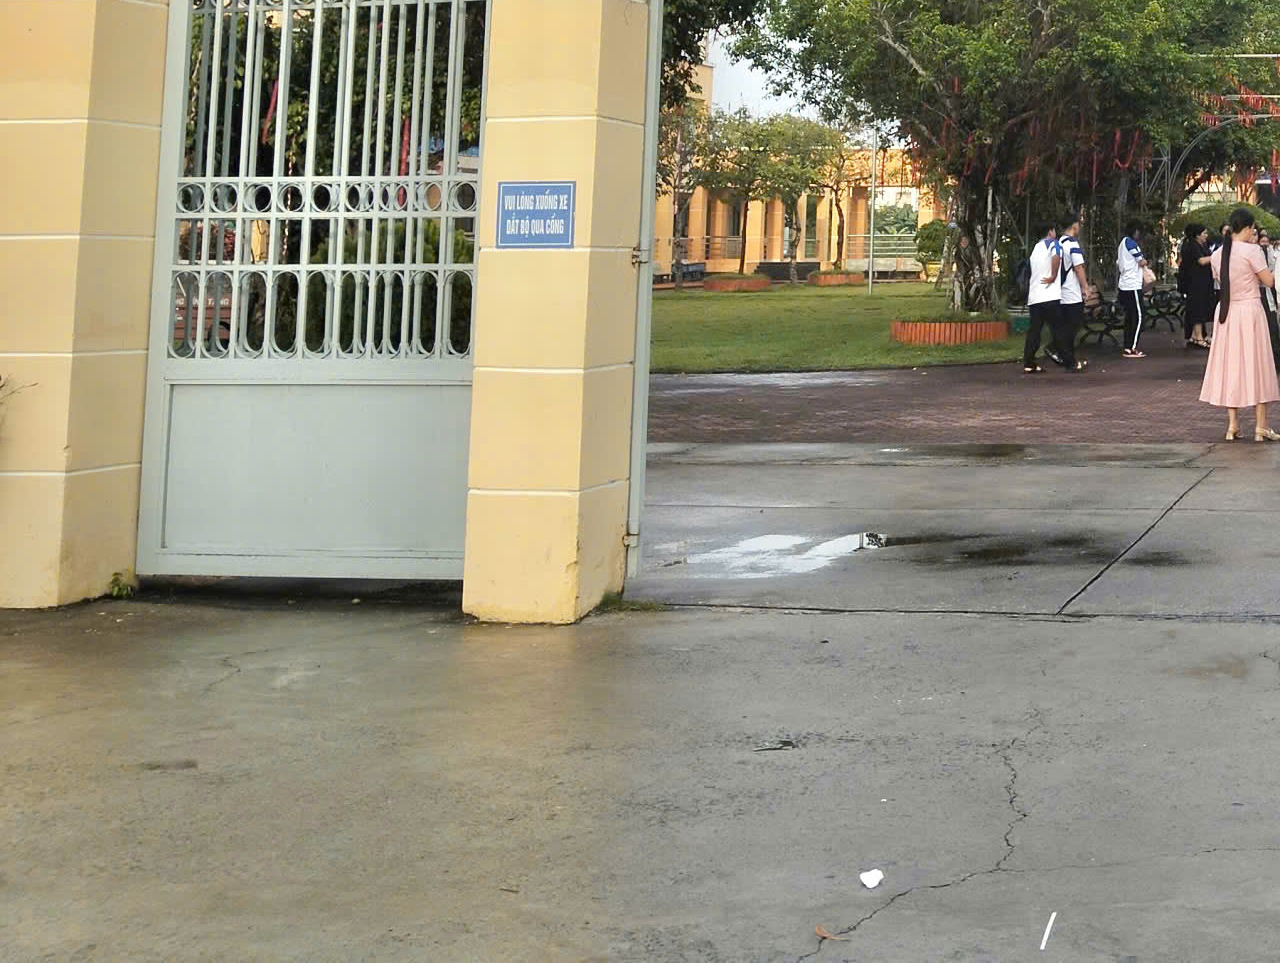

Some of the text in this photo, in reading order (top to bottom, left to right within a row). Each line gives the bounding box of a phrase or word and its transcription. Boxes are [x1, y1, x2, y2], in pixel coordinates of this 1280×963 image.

[505, 189, 568, 210] VUI LÒNG XUỐNG XE
[520, 216, 529, 238] BỘ
[531, 219, 544, 236] QUA
[546, 213, 564, 234] CỔNG
